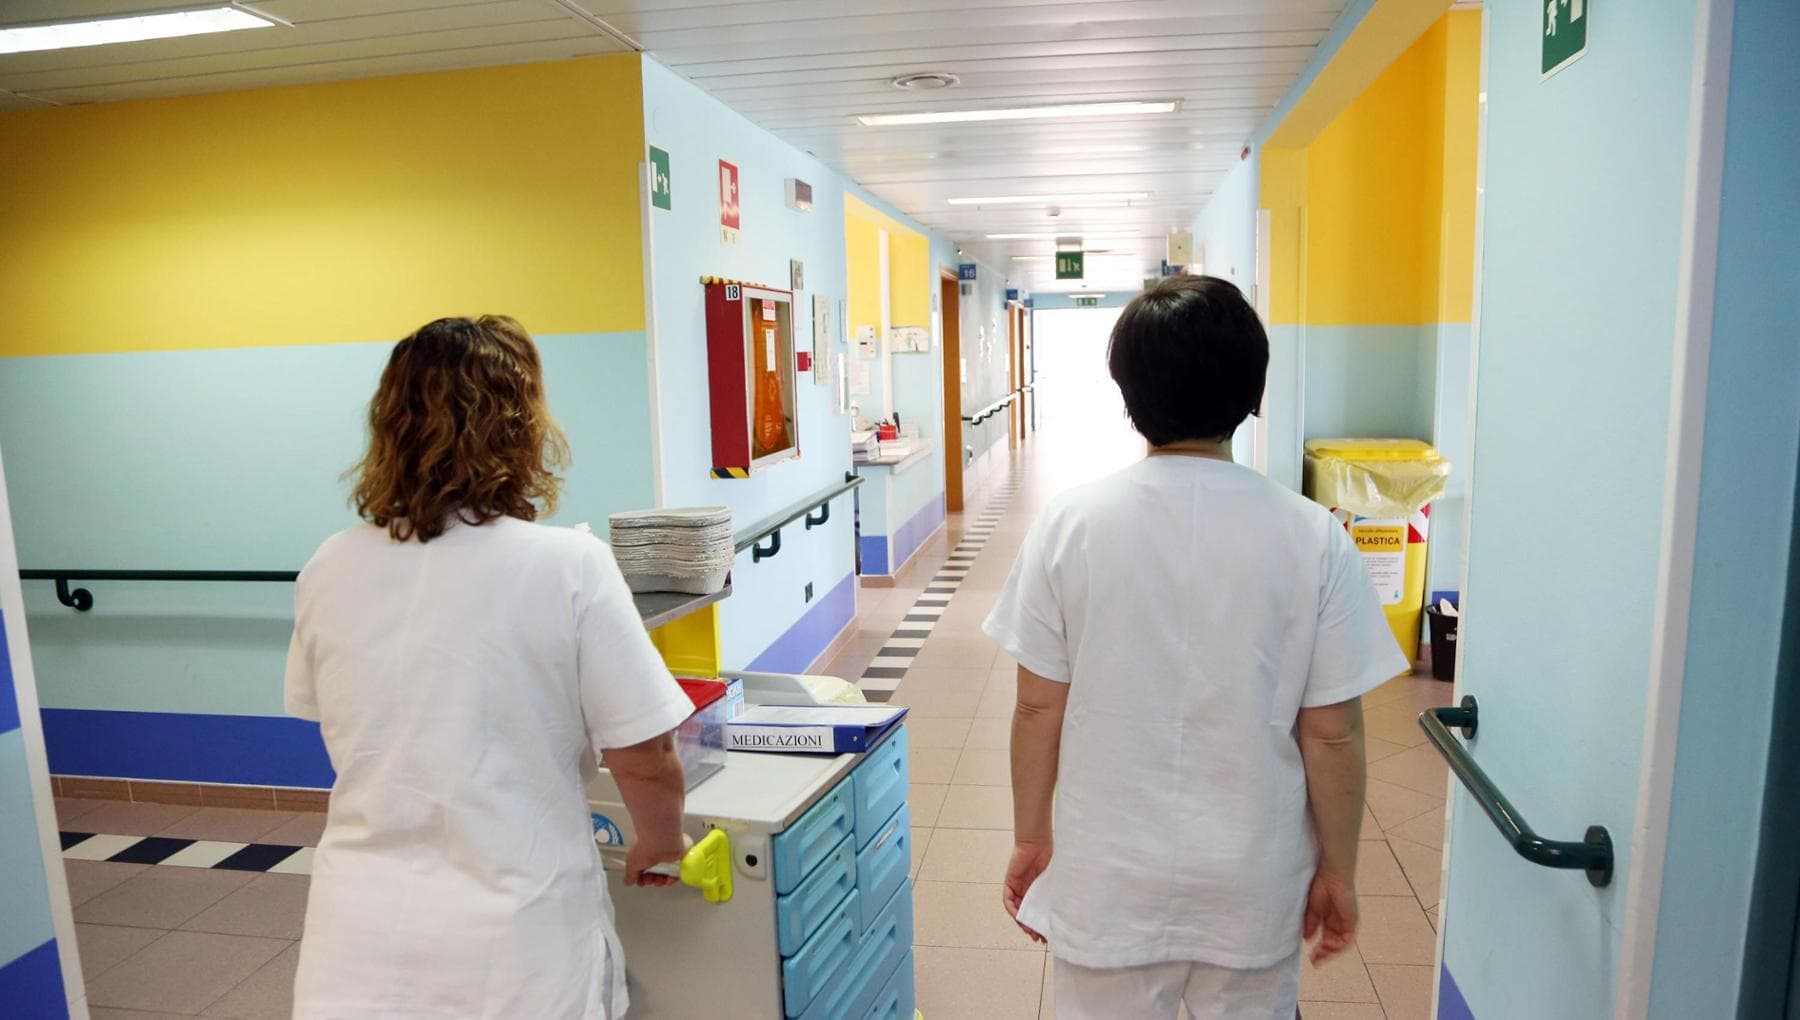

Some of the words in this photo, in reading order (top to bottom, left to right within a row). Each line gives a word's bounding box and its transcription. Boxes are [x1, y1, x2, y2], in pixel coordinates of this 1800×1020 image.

[727, 286, 738, 299] 18
[1355, 536, 1400, 545] PLASTICA
[732, 735, 822, 746] MEDICAZIONI
